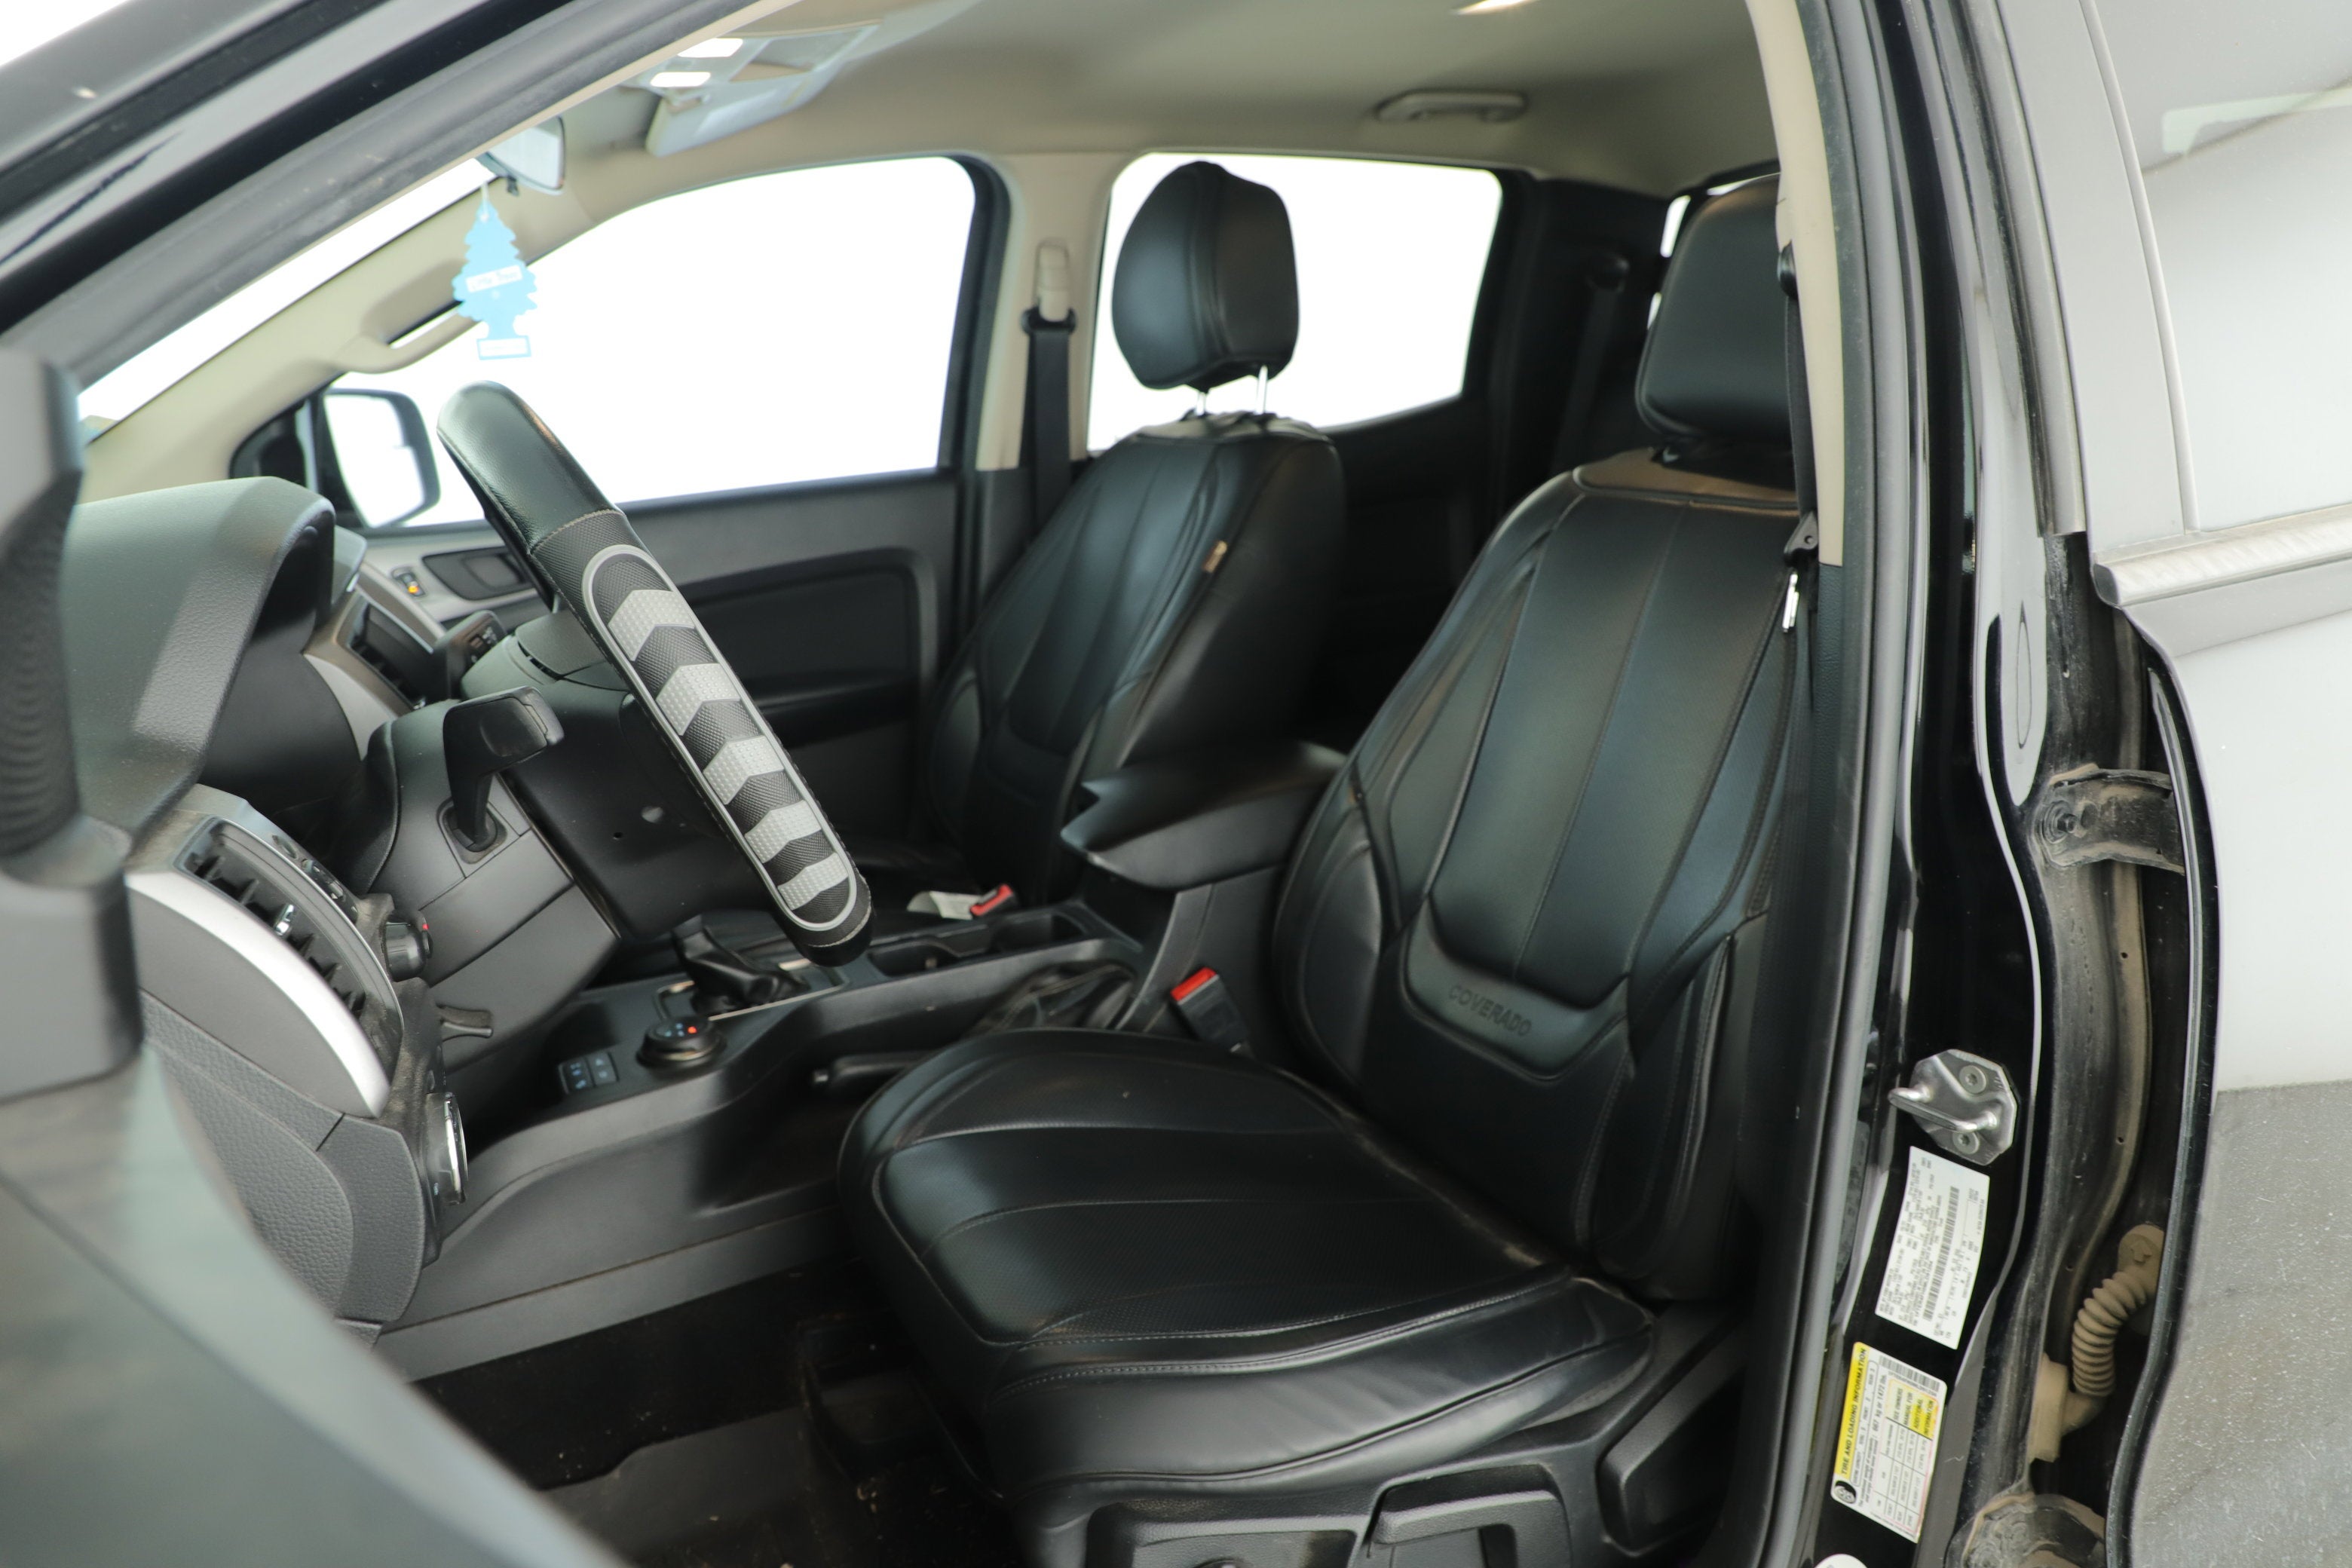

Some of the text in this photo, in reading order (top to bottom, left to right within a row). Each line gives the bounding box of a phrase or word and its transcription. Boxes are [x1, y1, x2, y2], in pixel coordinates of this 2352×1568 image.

[1448, 984, 1533, 1037] COVERADO
[1841, 1456, 1849, 1475] TIRE
[1846, 1403, 1857, 1438] LOADING
[1852, 1347, 1867, 1403] INFORMATION
[1876, 1401, 1882, 1409] or
[1894, 1386, 1903, 1410] OWNERS
[1874, 1408, 1882, 1419] kg
[1903, 1404, 1911, 1426] MANUAL
[1913, 1398, 1923, 1429] ADDITIONAL
[1922, 1399, 1934, 1435] INFORMATION
